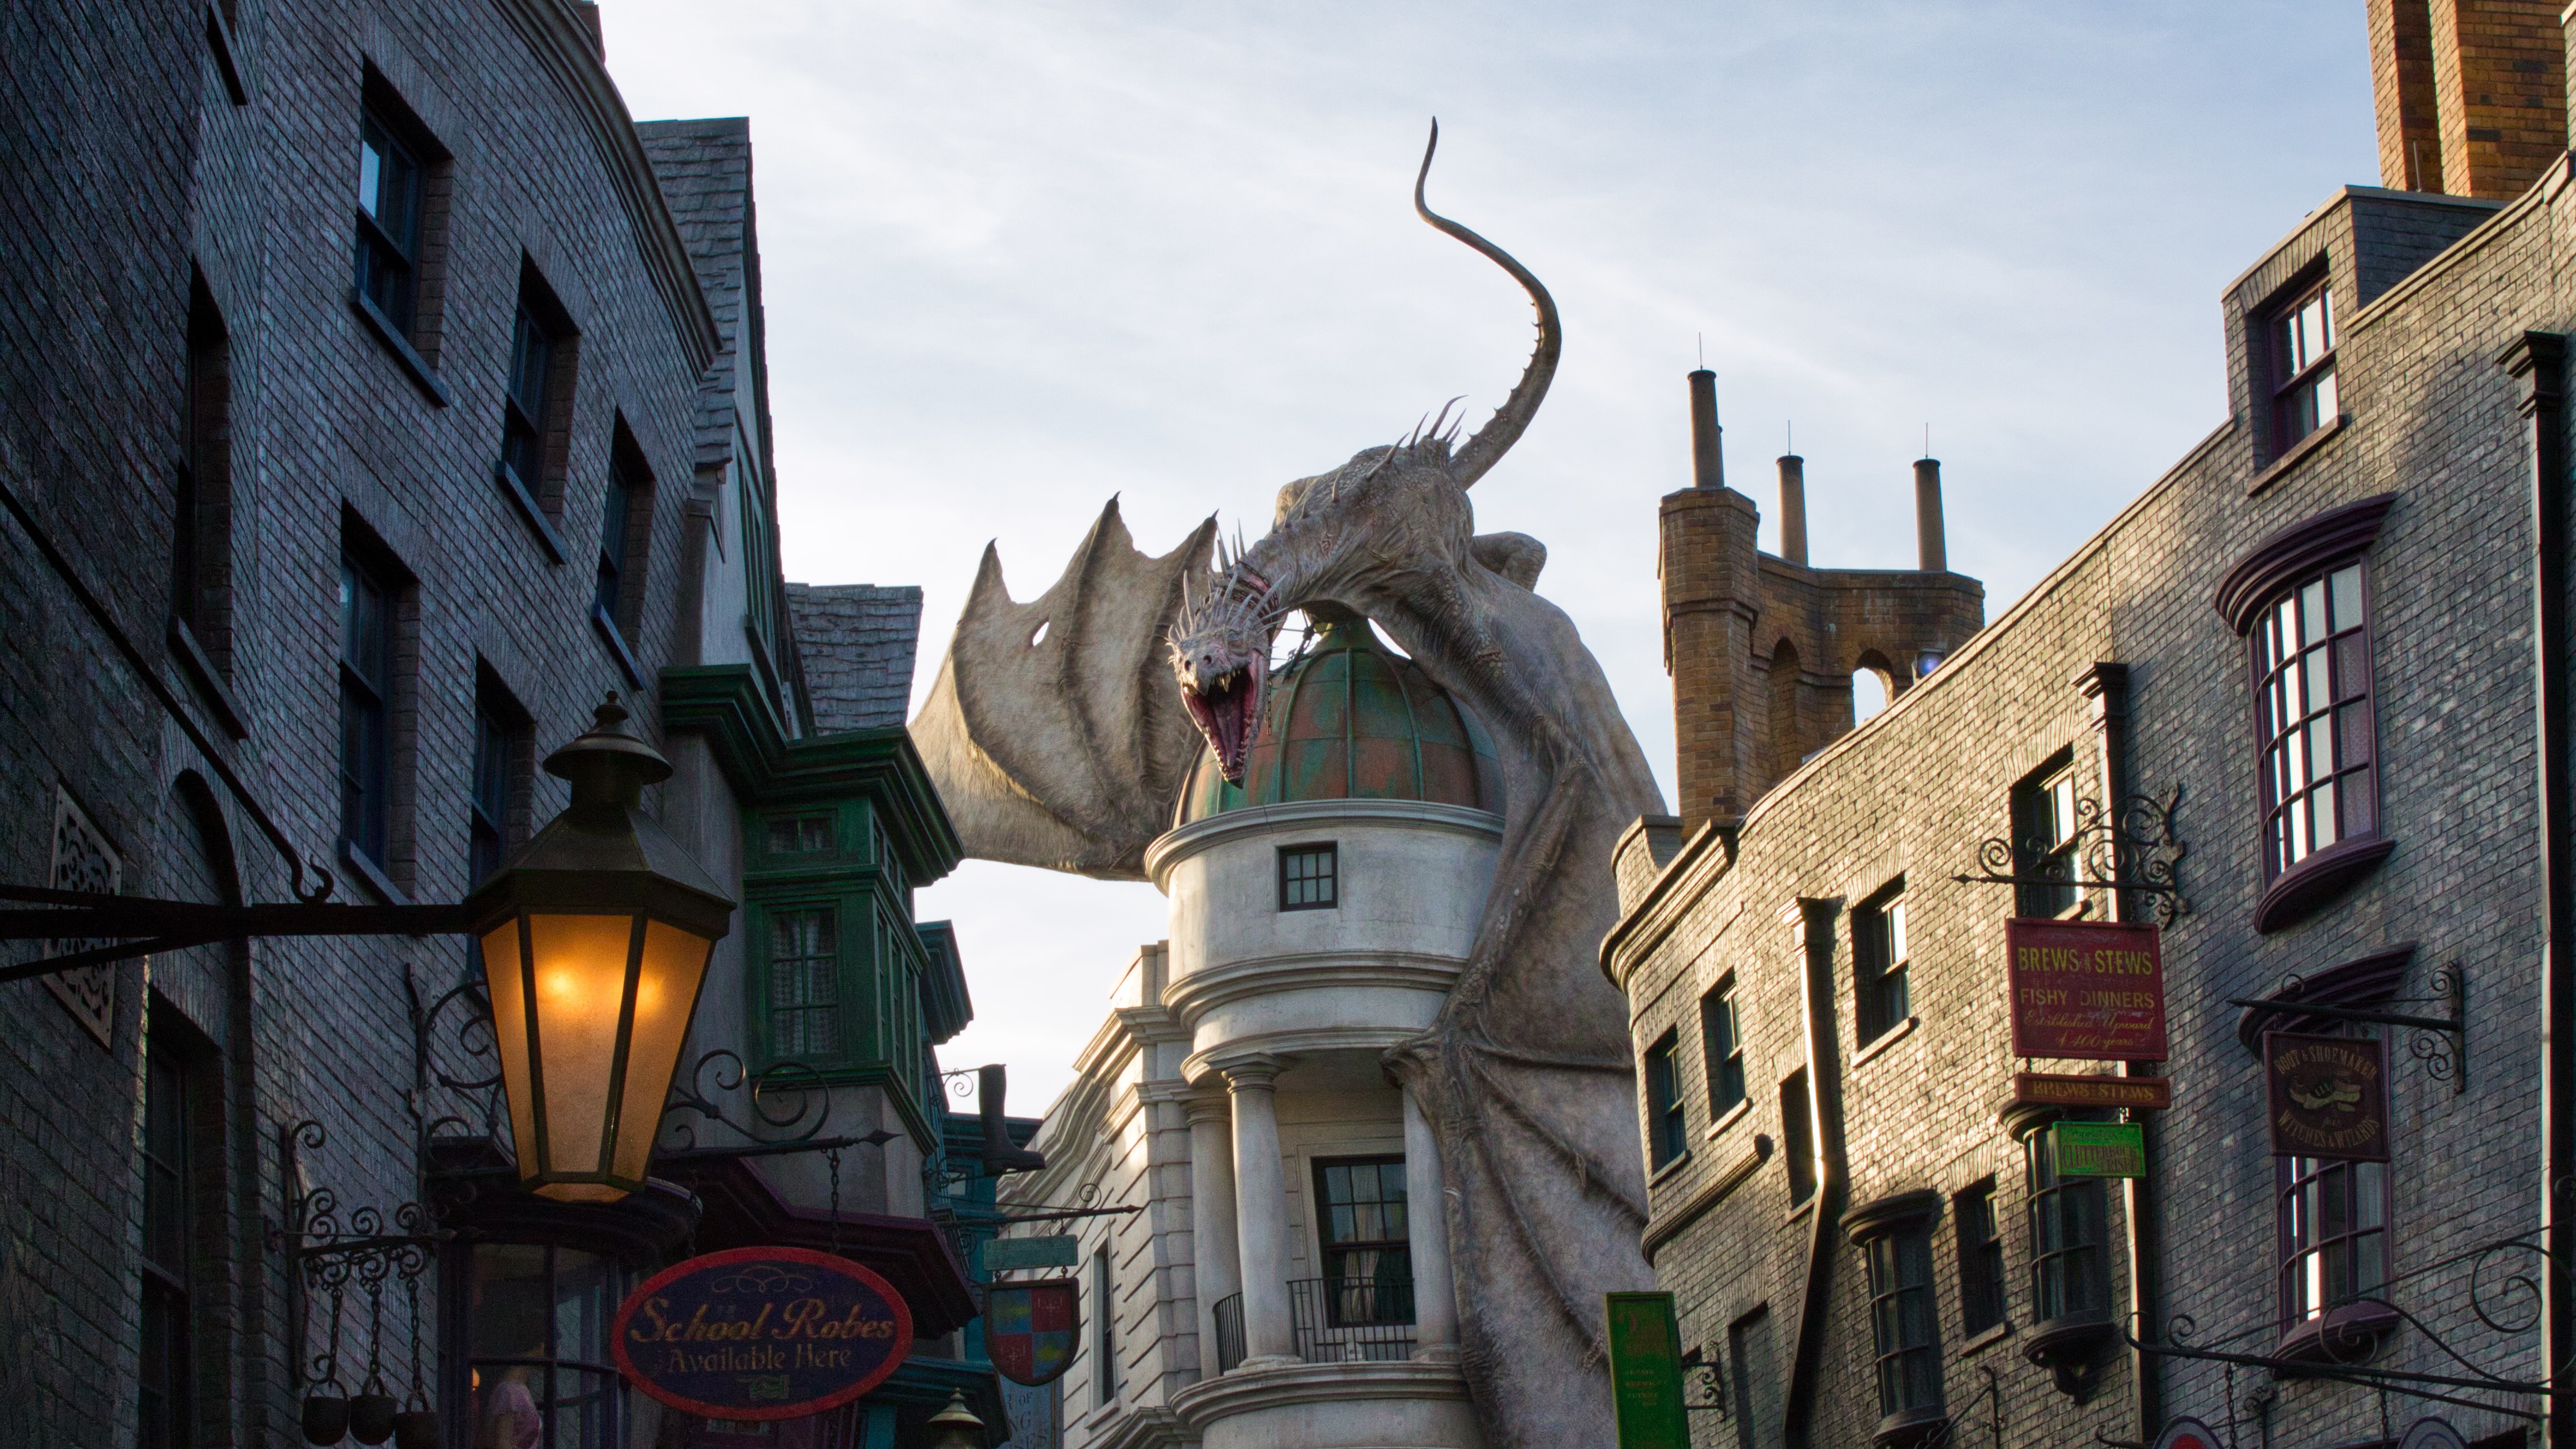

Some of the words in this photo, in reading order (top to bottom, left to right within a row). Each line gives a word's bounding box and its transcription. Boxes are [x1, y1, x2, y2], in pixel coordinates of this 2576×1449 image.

[2018, 947, 2081, 972] BREWS
[2094, 949, 2153, 975] STEWS
[2021, 988, 2068, 1005] FISHY
[2080, 990, 2154, 1009] DINNERS
[2274, 1049, 2300, 1074] BOOT
[2309, 1045, 2378, 1079] SHOEMAKER
[2033, 1081, 2090, 1098] BREWS
[2098, 1083, 2154, 1101] STEWS
[2277, 1110, 2327, 1148] WITCHES
[2334, 1114, 2380, 1148] WIZARDS
[630, 1298, 774, 1342] School
[772, 1298, 893, 1340] Robes
[668, 1345, 786, 1373] Available
[794, 1343, 853, 1369] Here
[1018, 1391, 1033, 1406] OF
